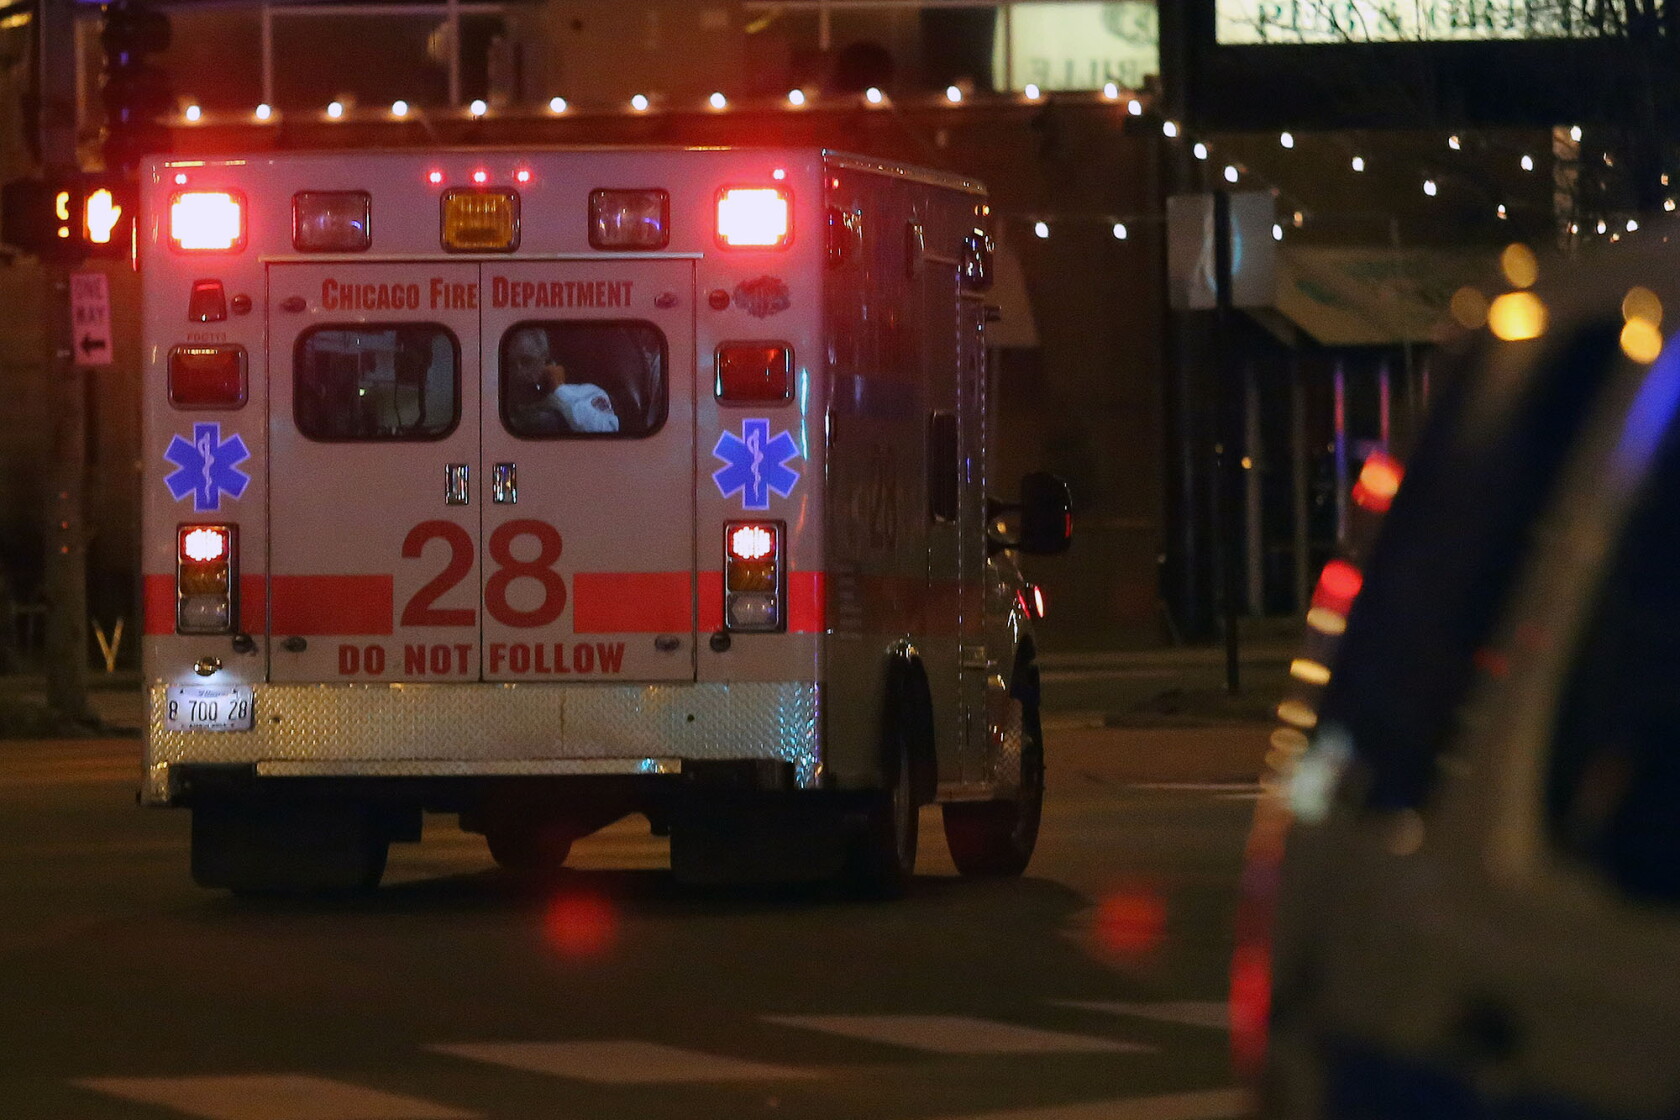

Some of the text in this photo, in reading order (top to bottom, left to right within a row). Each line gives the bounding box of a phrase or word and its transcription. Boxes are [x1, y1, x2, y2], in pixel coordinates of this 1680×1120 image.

[321, 275, 634, 311] CHICAGO FIRE DEPARTMENT
[400, 518, 567, 628] 28
[338, 642, 626, 676] DO NOT FOLLOW
[168, 700, 248, 722] 8 700 28
